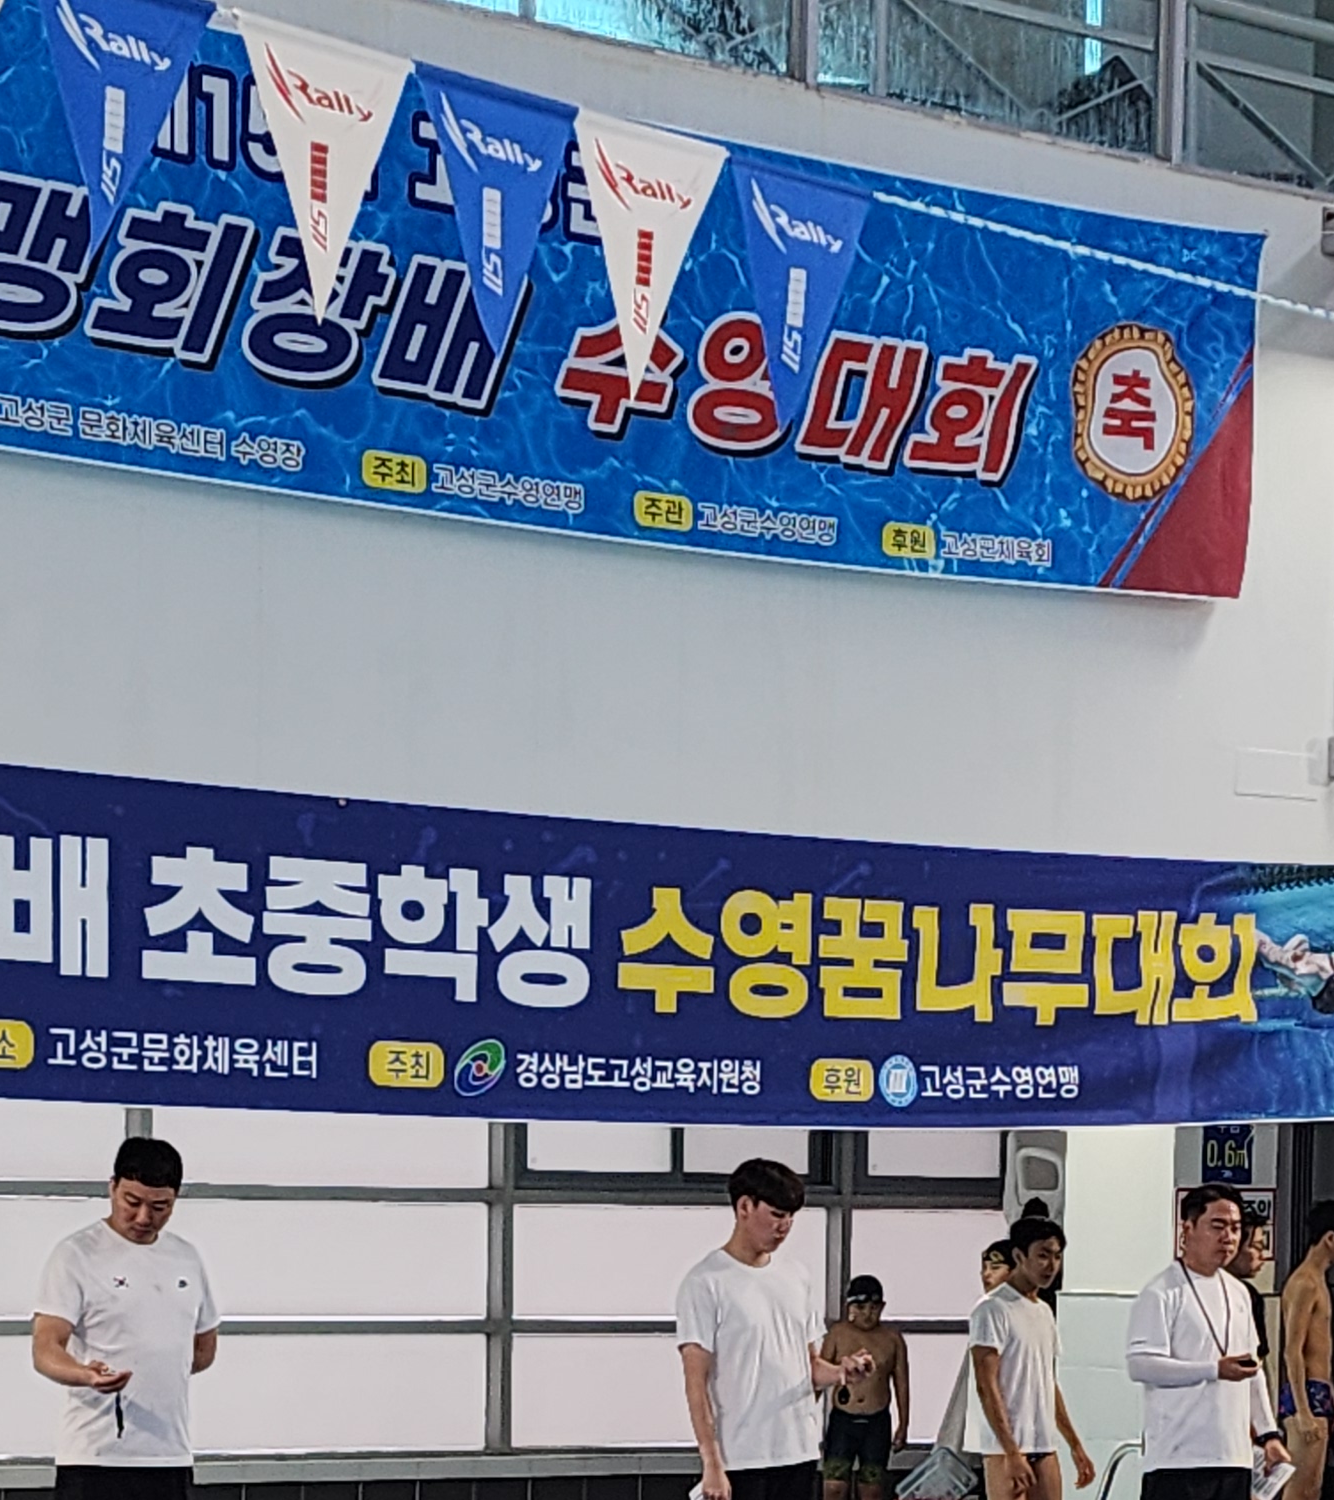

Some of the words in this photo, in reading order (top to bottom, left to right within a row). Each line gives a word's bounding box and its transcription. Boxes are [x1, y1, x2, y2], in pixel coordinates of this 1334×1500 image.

[78, 13, 172, 72] Rally
[286, 69, 374, 123] Rally
[461, 119, 543, 173] Rally
[615, 161, 693, 210] Rally
[769, 203, 843, 254] Rally
[1102, 368, 1157, 451] 축
[78, 407, 226, 461] 문화체육센터
[229, 430, 307, 471] 수영장
[371, 456, 418, 489] 주최
[430, 463, 586, 515] 고성군수영연맹
[643, 497, 685, 526] 주관
[696, 501, 839, 547] 고성군수영연맹
[890, 527, 928, 554] 후원
[939, 530, 1054, 567] 고성군체육회
[141, 846, 593, 1008] 초중학생
[616, 886, 1259, 1026] 수영꿈나무대회
[46, 1026, 319, 1080] 고성군문화체육센터
[384, 1049, 432, 1082] 주최
[515, 1051, 763, 1097] 경상남도고성교육지원청
[823, 1064, 863, 1096] 후원
[919, 1063, 1081, 1100] 고성군수영연맹
